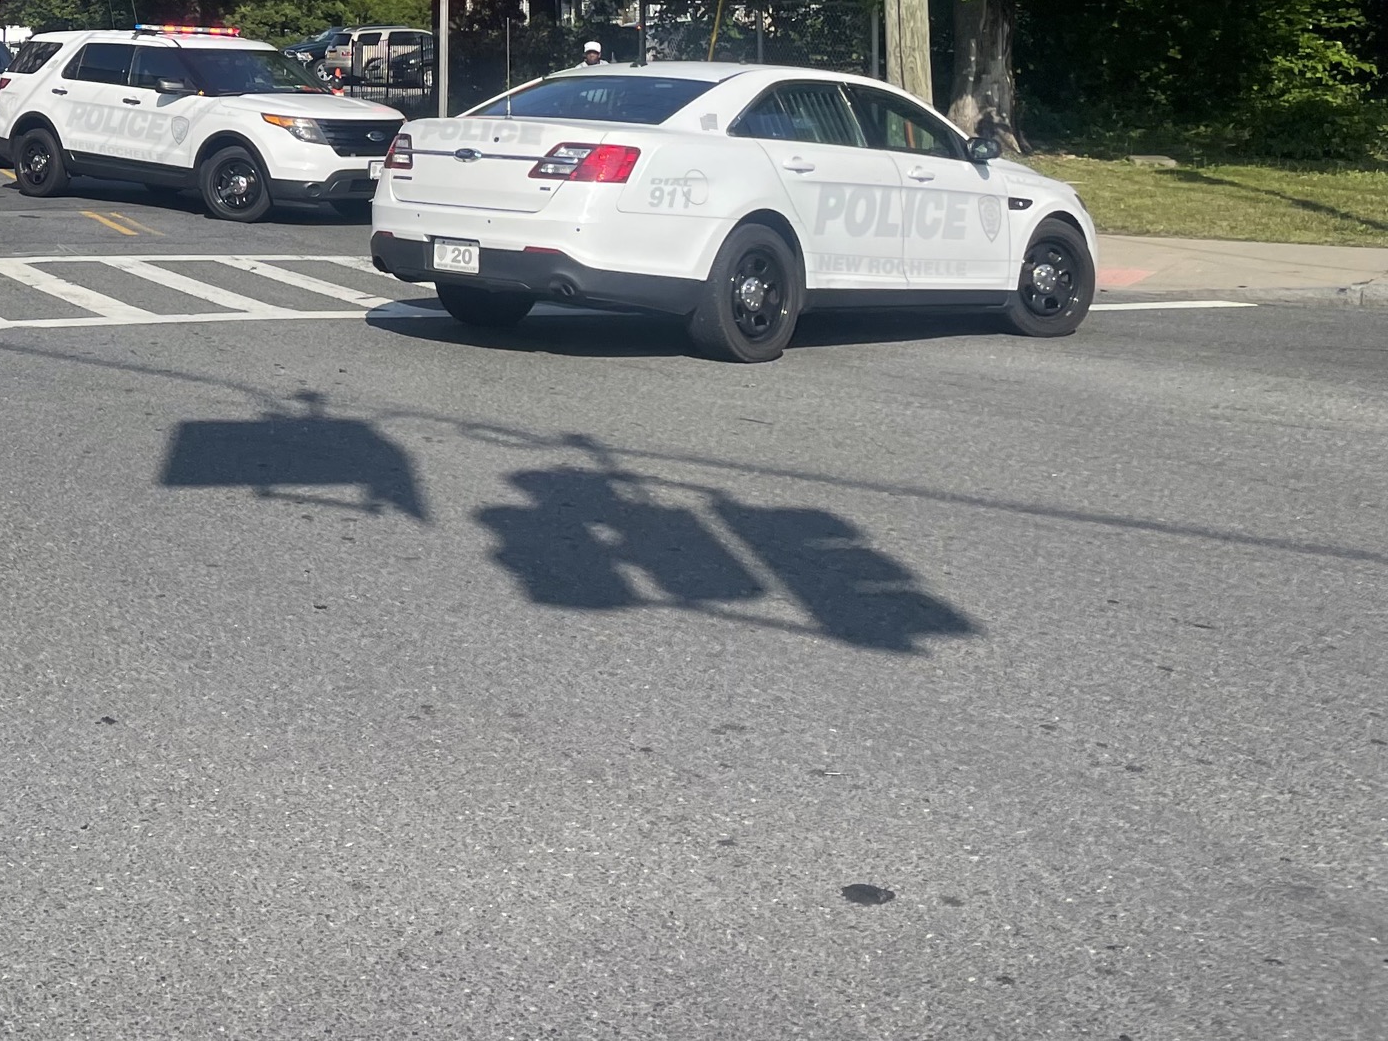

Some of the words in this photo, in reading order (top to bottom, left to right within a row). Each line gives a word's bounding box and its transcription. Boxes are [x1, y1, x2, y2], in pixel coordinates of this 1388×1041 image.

[65, 102, 170, 140] POLICE
[419, 119, 545, 145] POLICE
[69, 139, 95, 150] NEW
[650, 177, 692, 187] DIAL
[648, 186, 692, 209] 911
[813, 183, 970, 240] POLICE
[451, 247, 472, 265] 20
[818, 254, 866, 272] NEW
[867, 259, 967, 276] ROCHELLE
